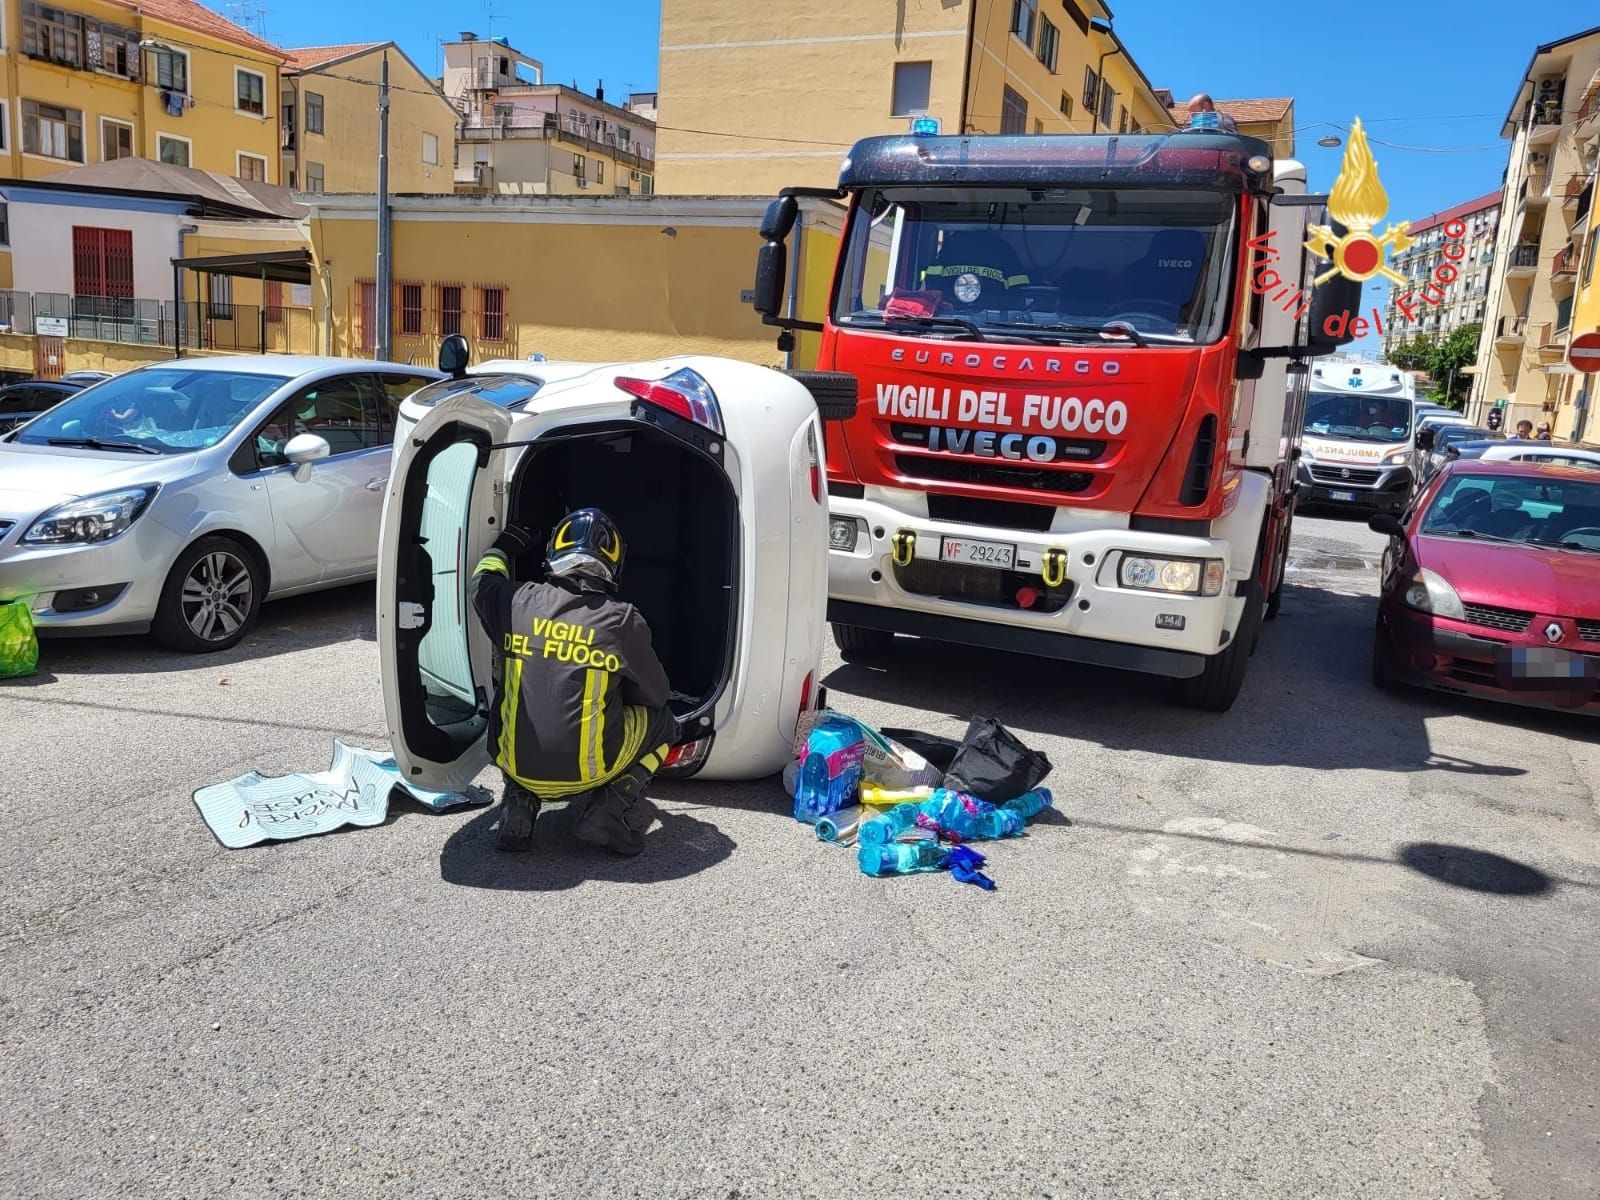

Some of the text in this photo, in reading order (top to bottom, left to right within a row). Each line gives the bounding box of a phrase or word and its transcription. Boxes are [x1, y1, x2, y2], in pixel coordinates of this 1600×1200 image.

[1157, 259, 1193, 268] IVECO
[891, 348, 1121, 375] EUROCARGO
[876, 383, 1128, 435] VIGILI DEL FUOCO
[928, 426, 1057, 463] IVECO
[946, 541, 1010, 563] VF 29243
[532, 616, 596, 646] VIGILI
[504, 633, 620, 673] DEL FUOCO
